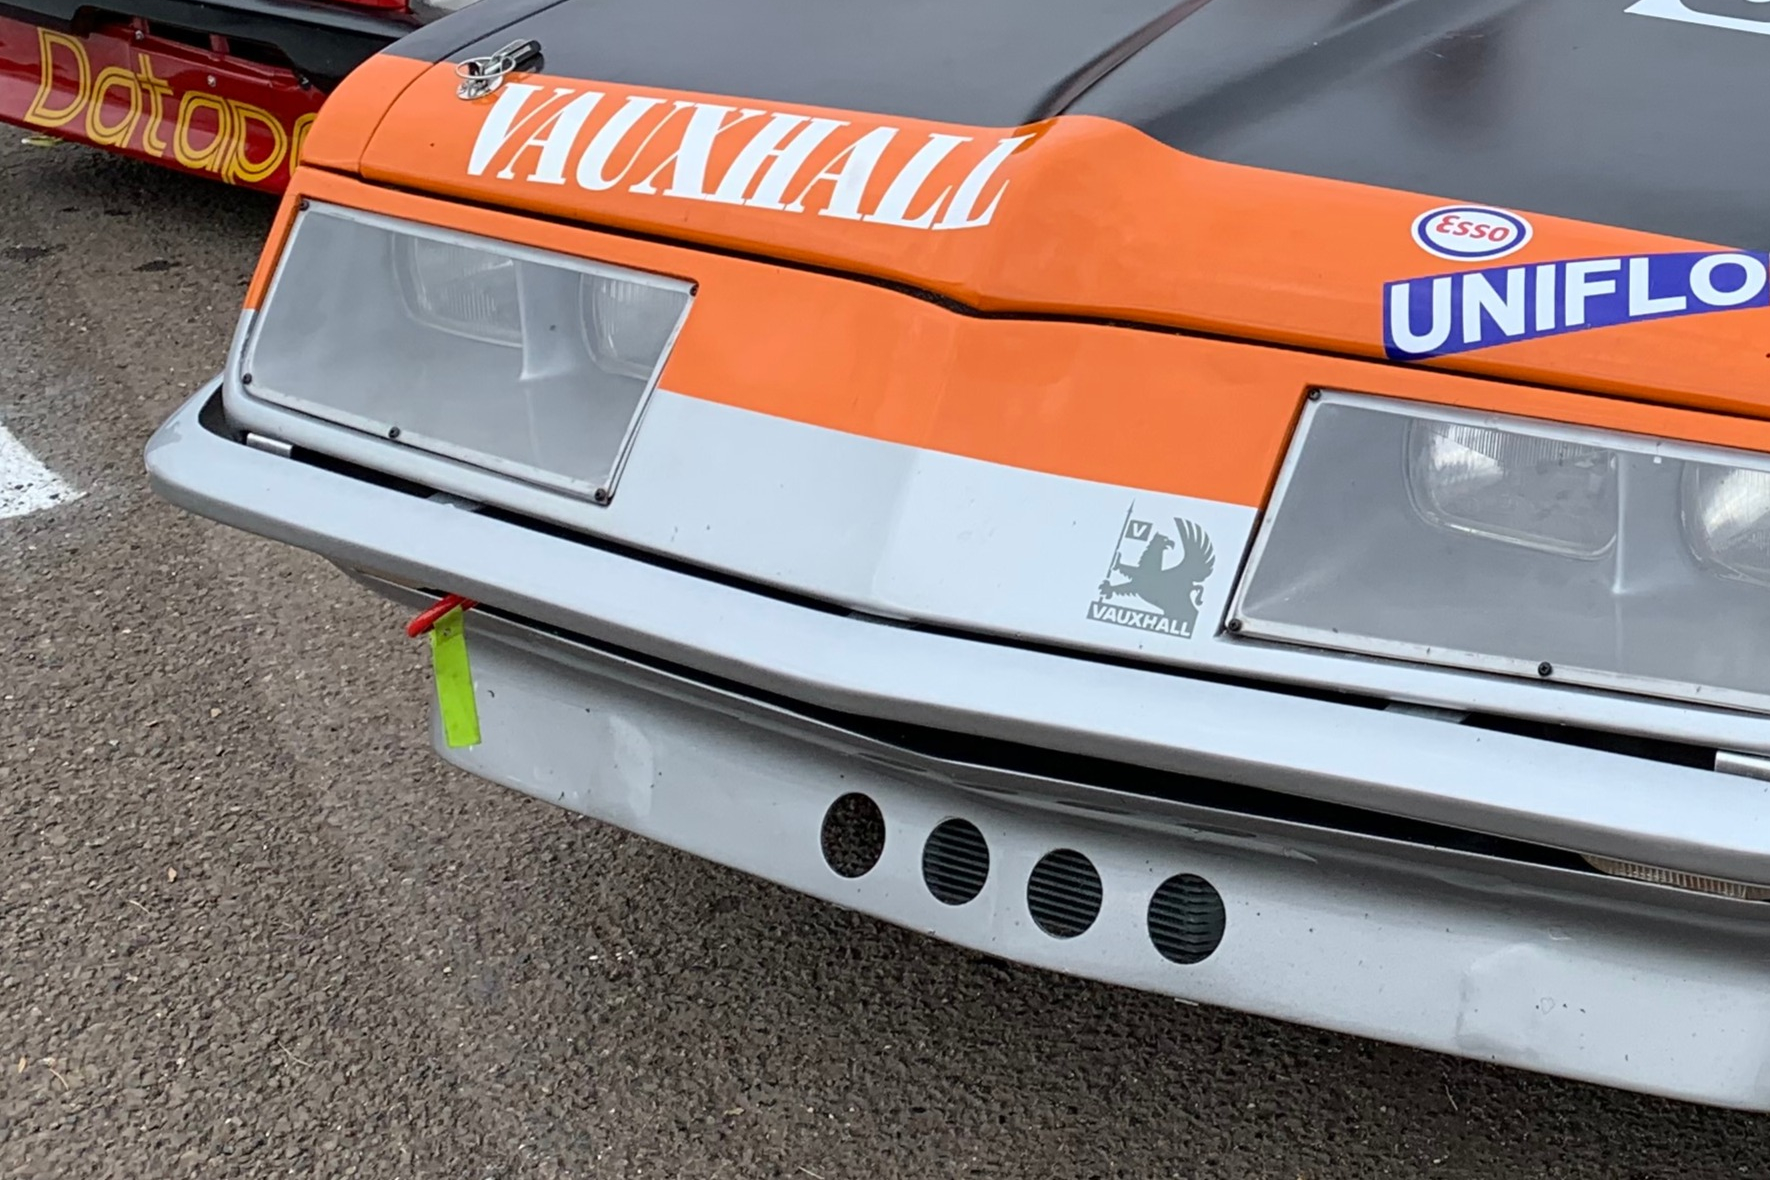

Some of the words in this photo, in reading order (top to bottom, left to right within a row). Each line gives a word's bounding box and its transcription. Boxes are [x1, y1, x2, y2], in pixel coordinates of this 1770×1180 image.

[467, 82, 1036, 231] VAUXHALL
[1391, 253, 1766, 354] UNIFLO
[1132, 522, 1148, 537] V
[1092, 603, 1191, 637] VAUXHALL
